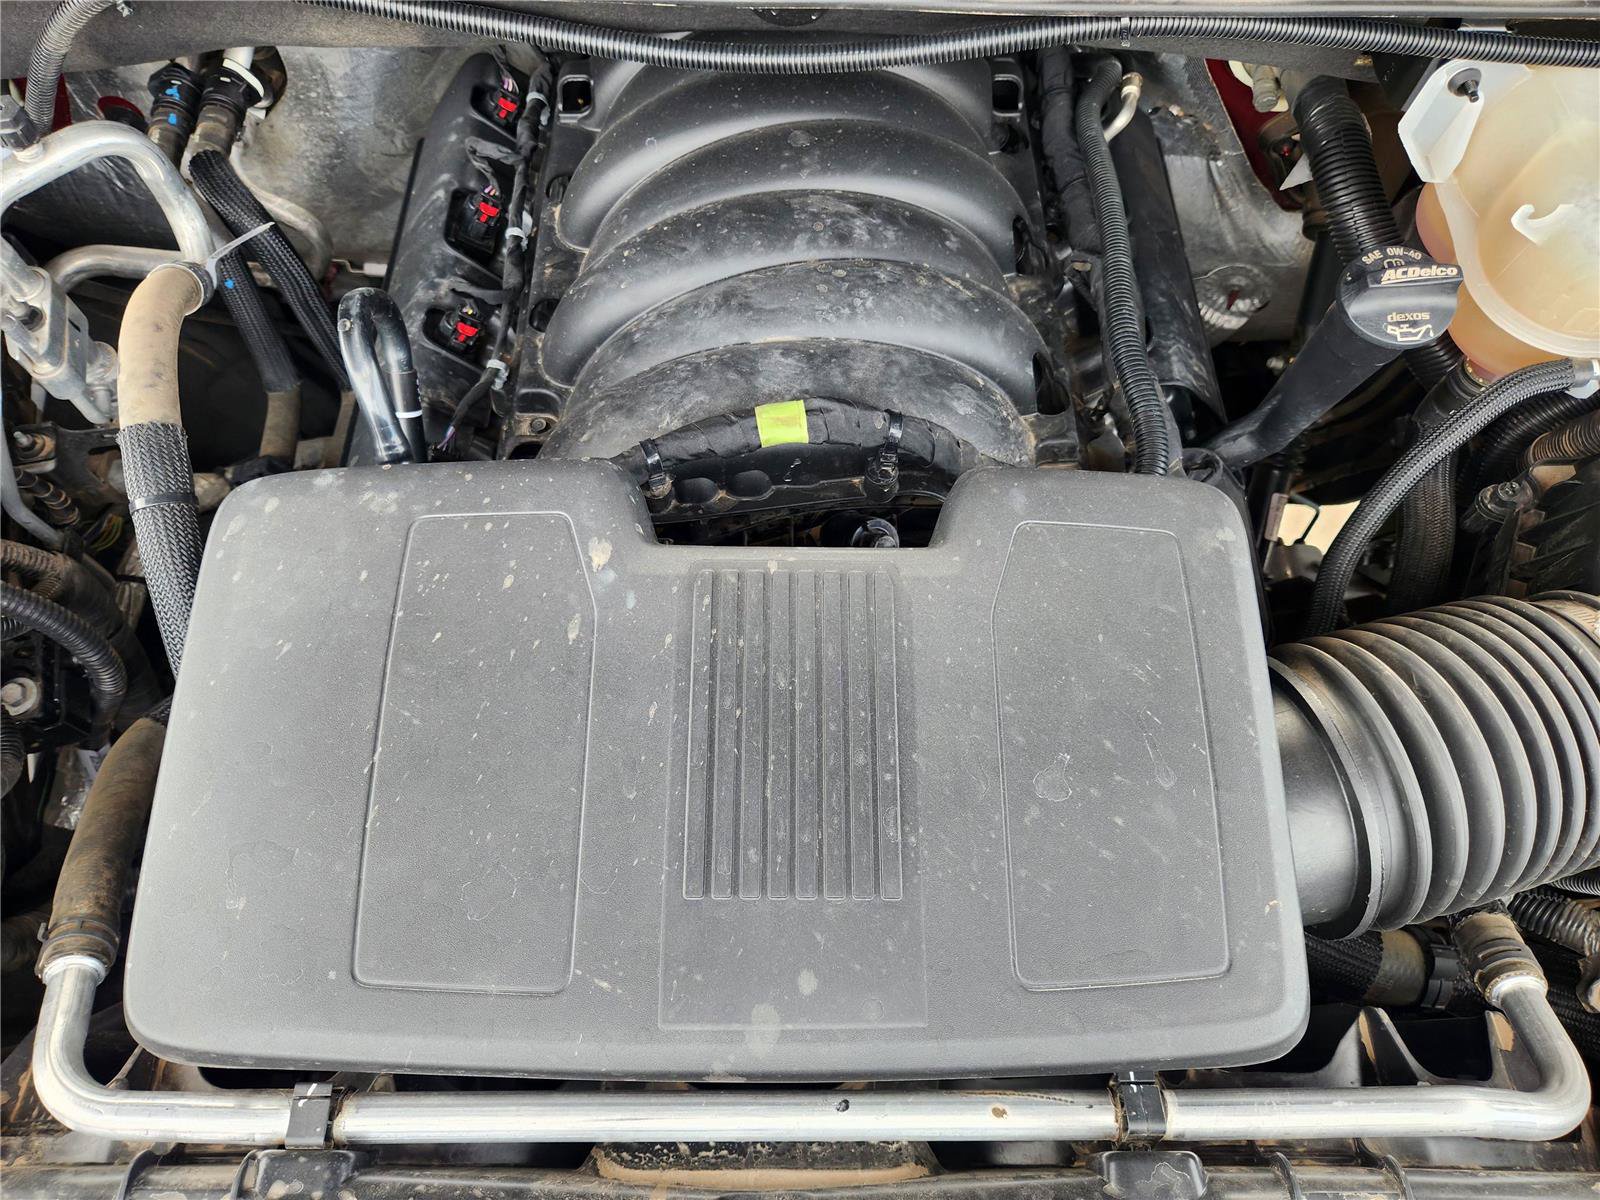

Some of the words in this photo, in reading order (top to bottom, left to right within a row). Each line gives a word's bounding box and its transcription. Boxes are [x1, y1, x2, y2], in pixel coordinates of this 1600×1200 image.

[1362, 249, 1383, 265] SAE
[1381, 265, 1458, 282] ACDelco
[1387, 312, 1431, 322] dexos
